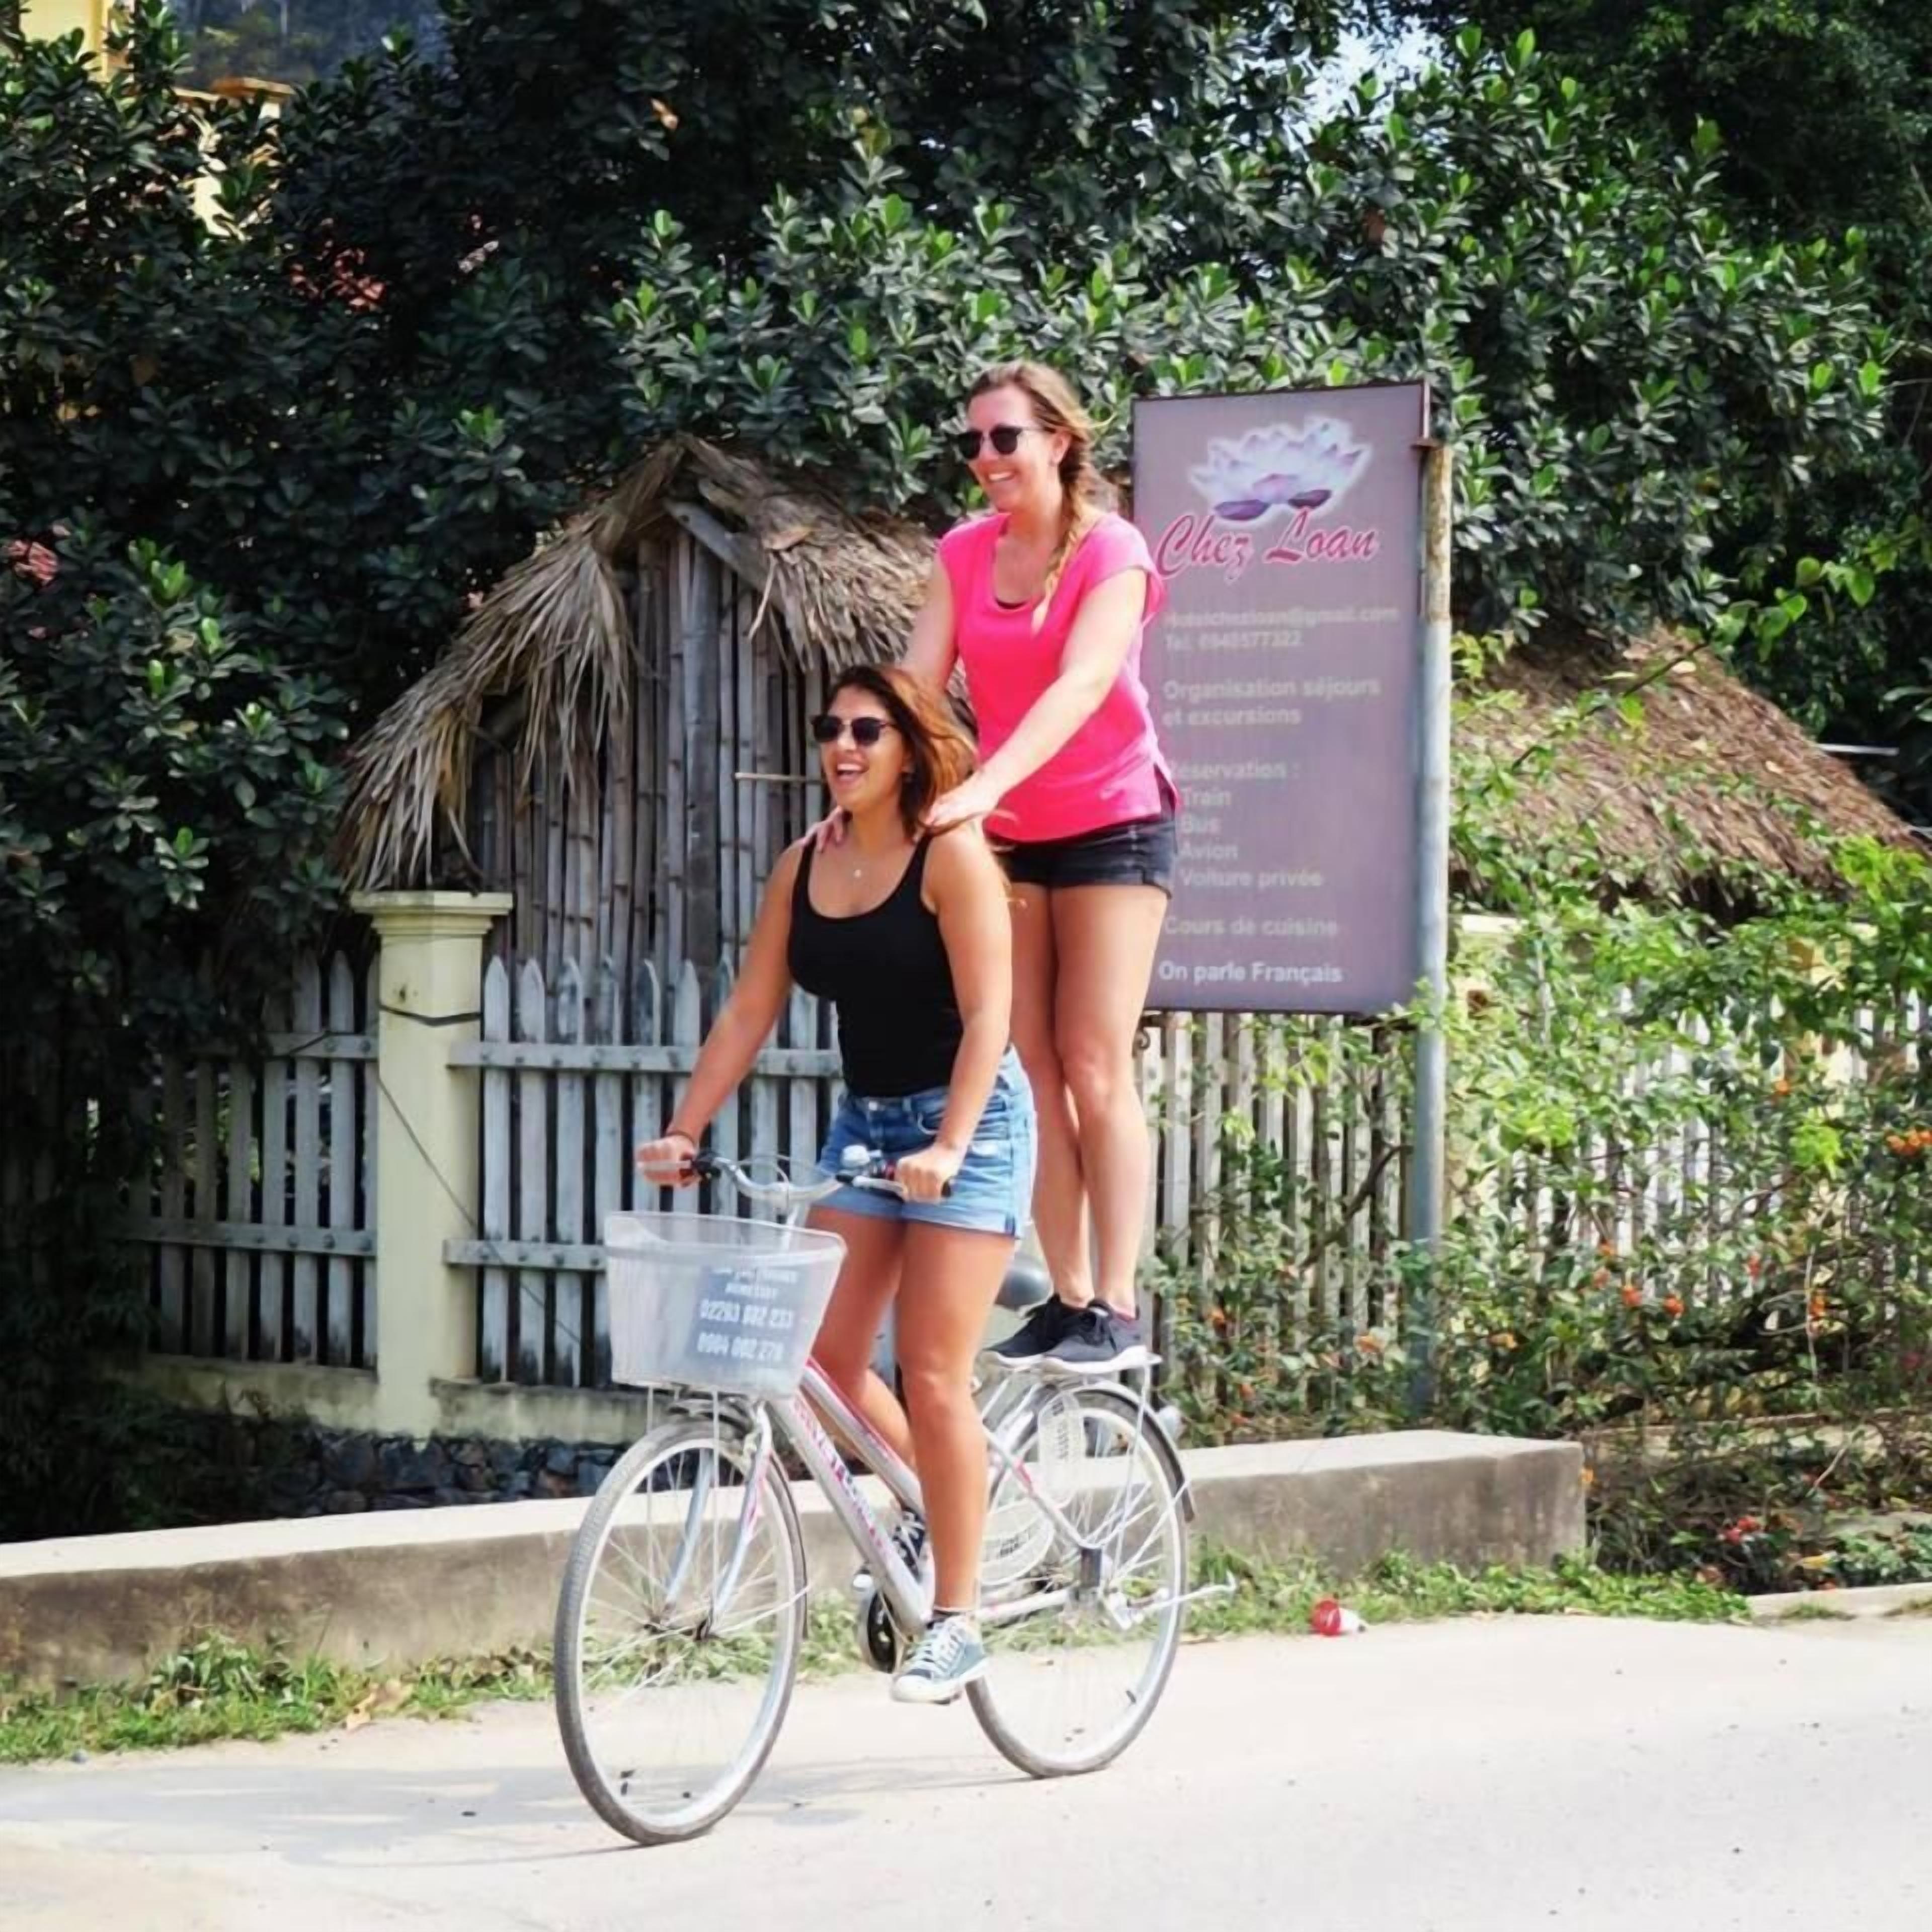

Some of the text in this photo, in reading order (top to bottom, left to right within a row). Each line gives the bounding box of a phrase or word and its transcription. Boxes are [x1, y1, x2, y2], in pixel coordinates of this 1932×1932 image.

[1156, 506, 1379, 583] Chez Loan
[1163, 676, 1381, 703] Organisation séjours
[1162, 705, 1302, 727] et excursions
[1180, 787, 1232, 806] Train
[1180, 814, 1221, 834] Bus
[1180, 839, 1239, 860] Avion
[1179, 868, 1325, 892] Voiture privée
[1164, 915, 1338, 937] Cours de cuisine
[1158, 960, 1343, 986] On parle Français
